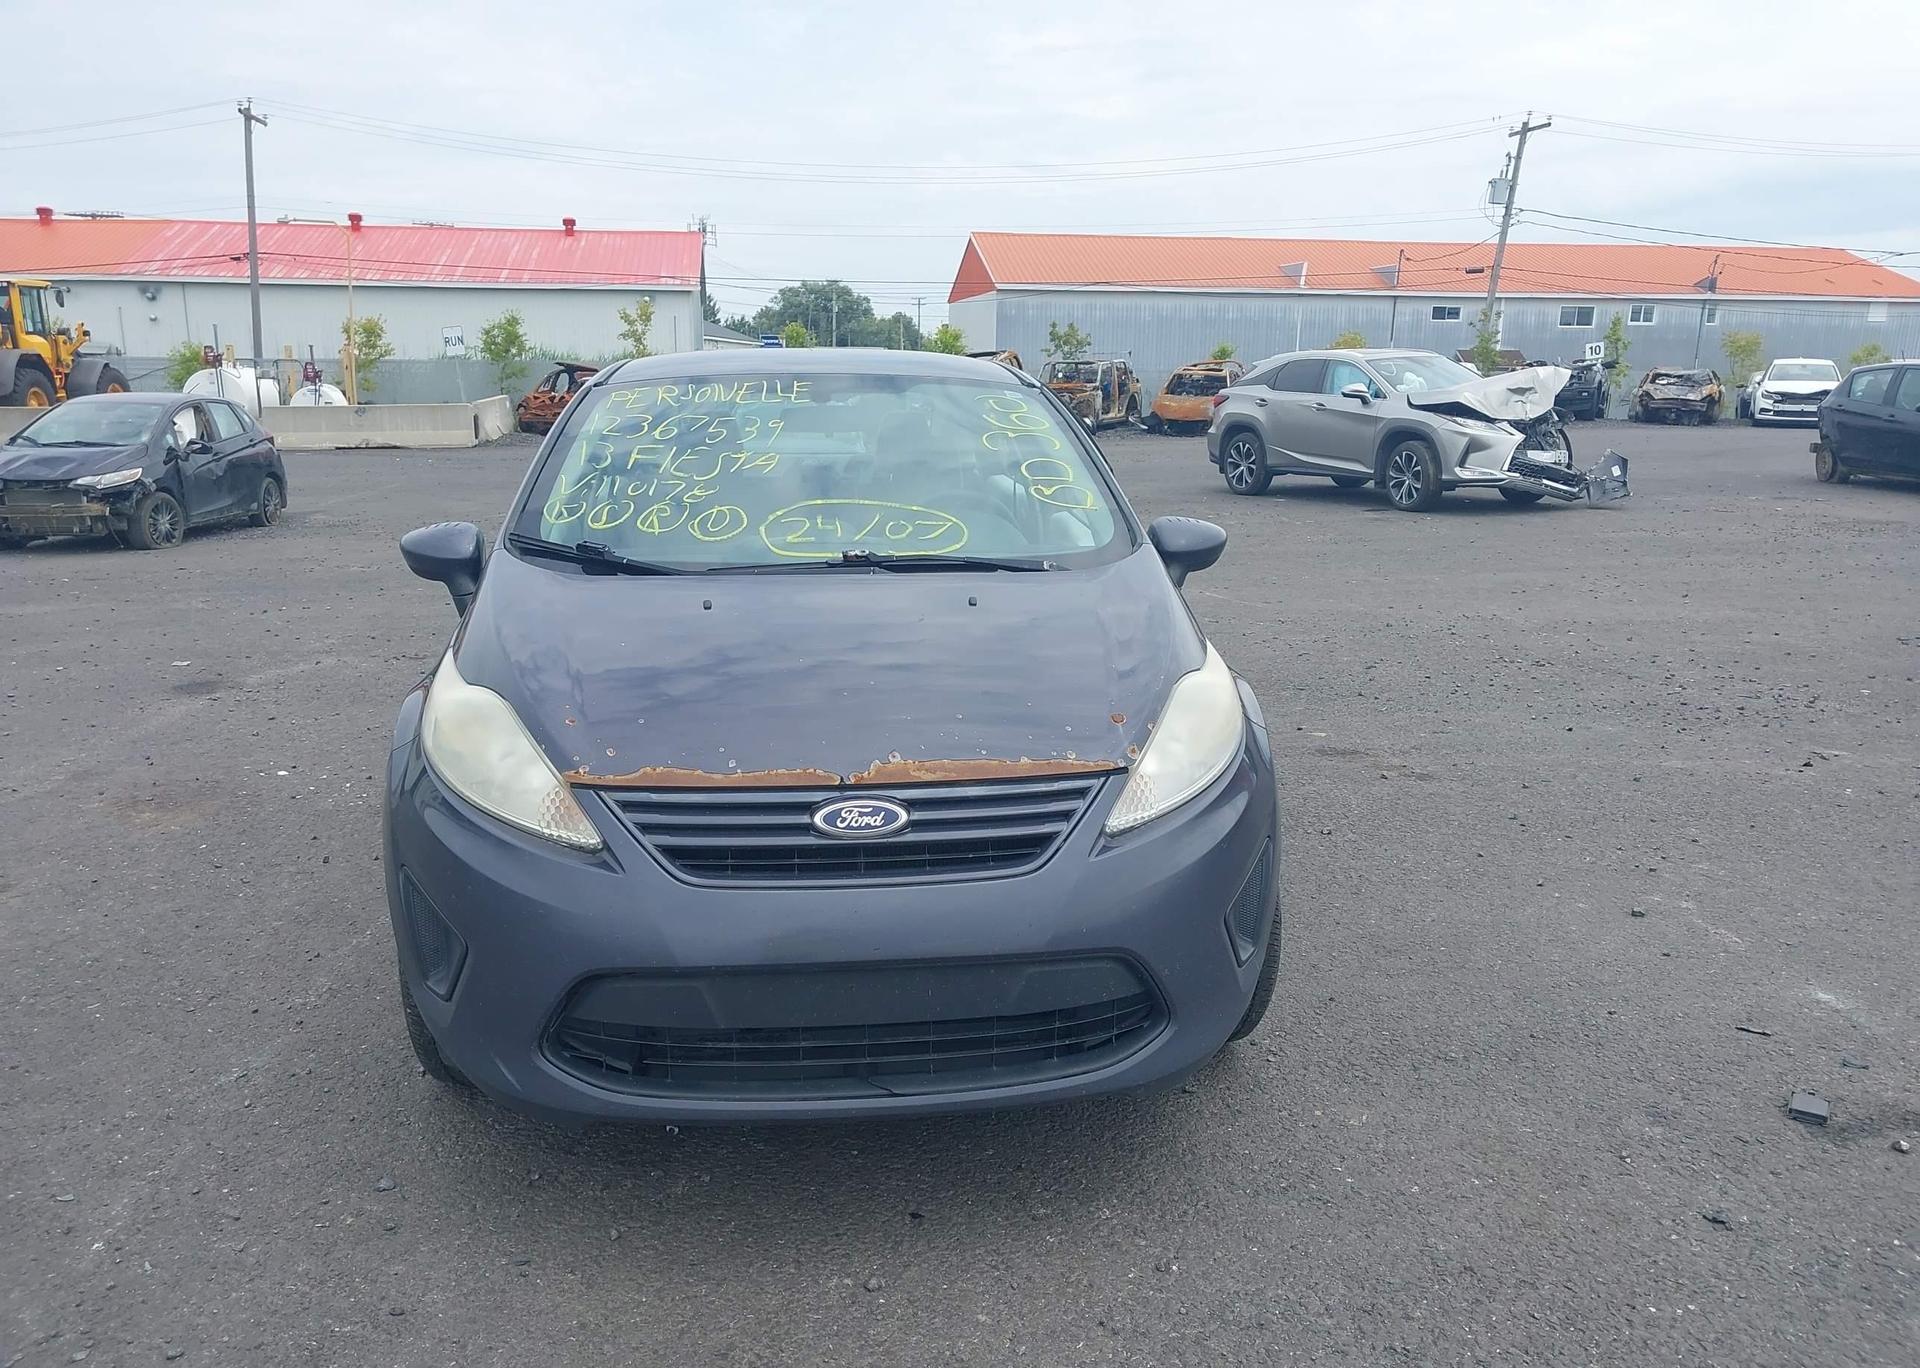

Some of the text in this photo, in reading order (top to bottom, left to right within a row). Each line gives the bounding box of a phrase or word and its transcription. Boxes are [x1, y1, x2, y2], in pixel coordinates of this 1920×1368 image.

[444, 335, 464, 347] RUN
[1589, 344, 1602, 356] 10
[589, 412, 785, 448] 12367539
[974, 394, 1061, 450] 360
[579, 440, 780, 480] 13 FIESTA
[780, 512, 954, 542] 24/07
[836, 807, 885, 829] Ford
